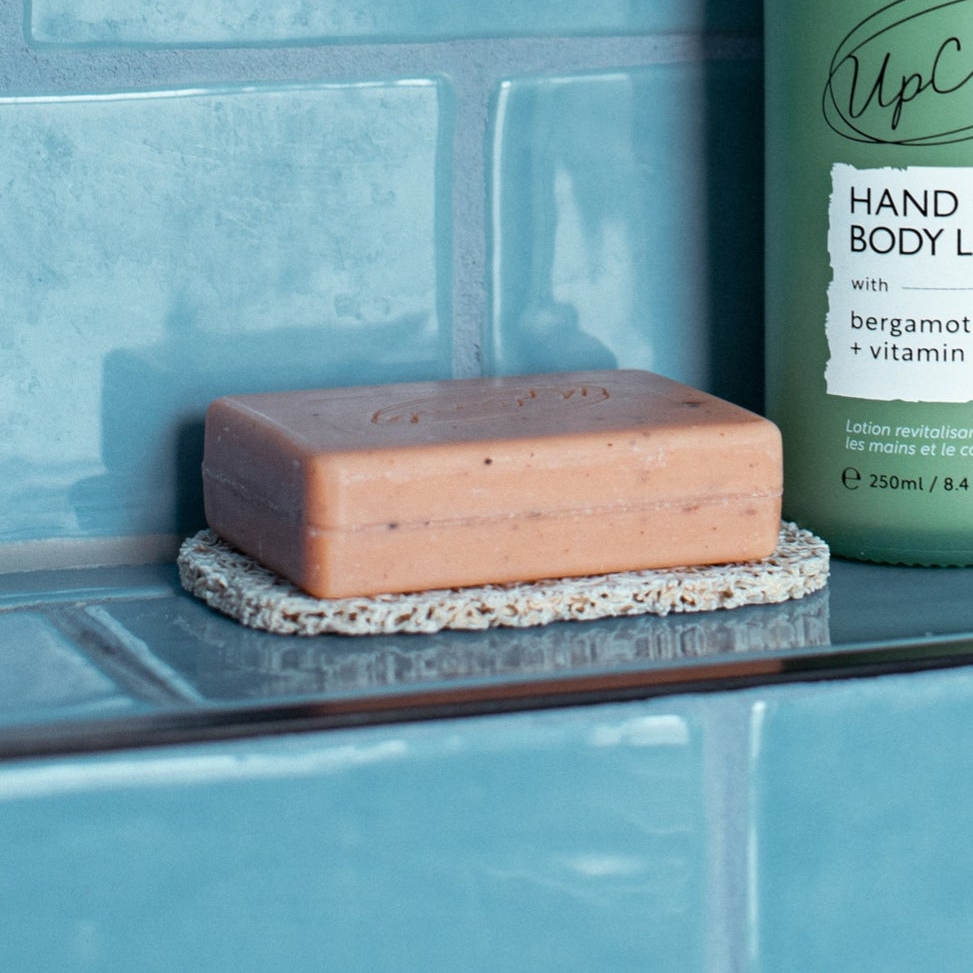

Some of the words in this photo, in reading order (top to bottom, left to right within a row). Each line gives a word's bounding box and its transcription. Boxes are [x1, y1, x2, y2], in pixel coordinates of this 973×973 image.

[850, 186, 959, 217] HAND
[850, 225, 945, 256] BODY
[851, 277, 889, 292] with
[870, 342, 965, 362] vitamin
[845, 419, 891, 437] Lotion
[845, 436, 864, 451] les
[869, 440, 916, 456] mains
[920, 443, 936, 456] et
[941, 442, 956, 457] le
[869, 474, 924, 491] 250ml
[943, 477, 969, 491] 8.4
